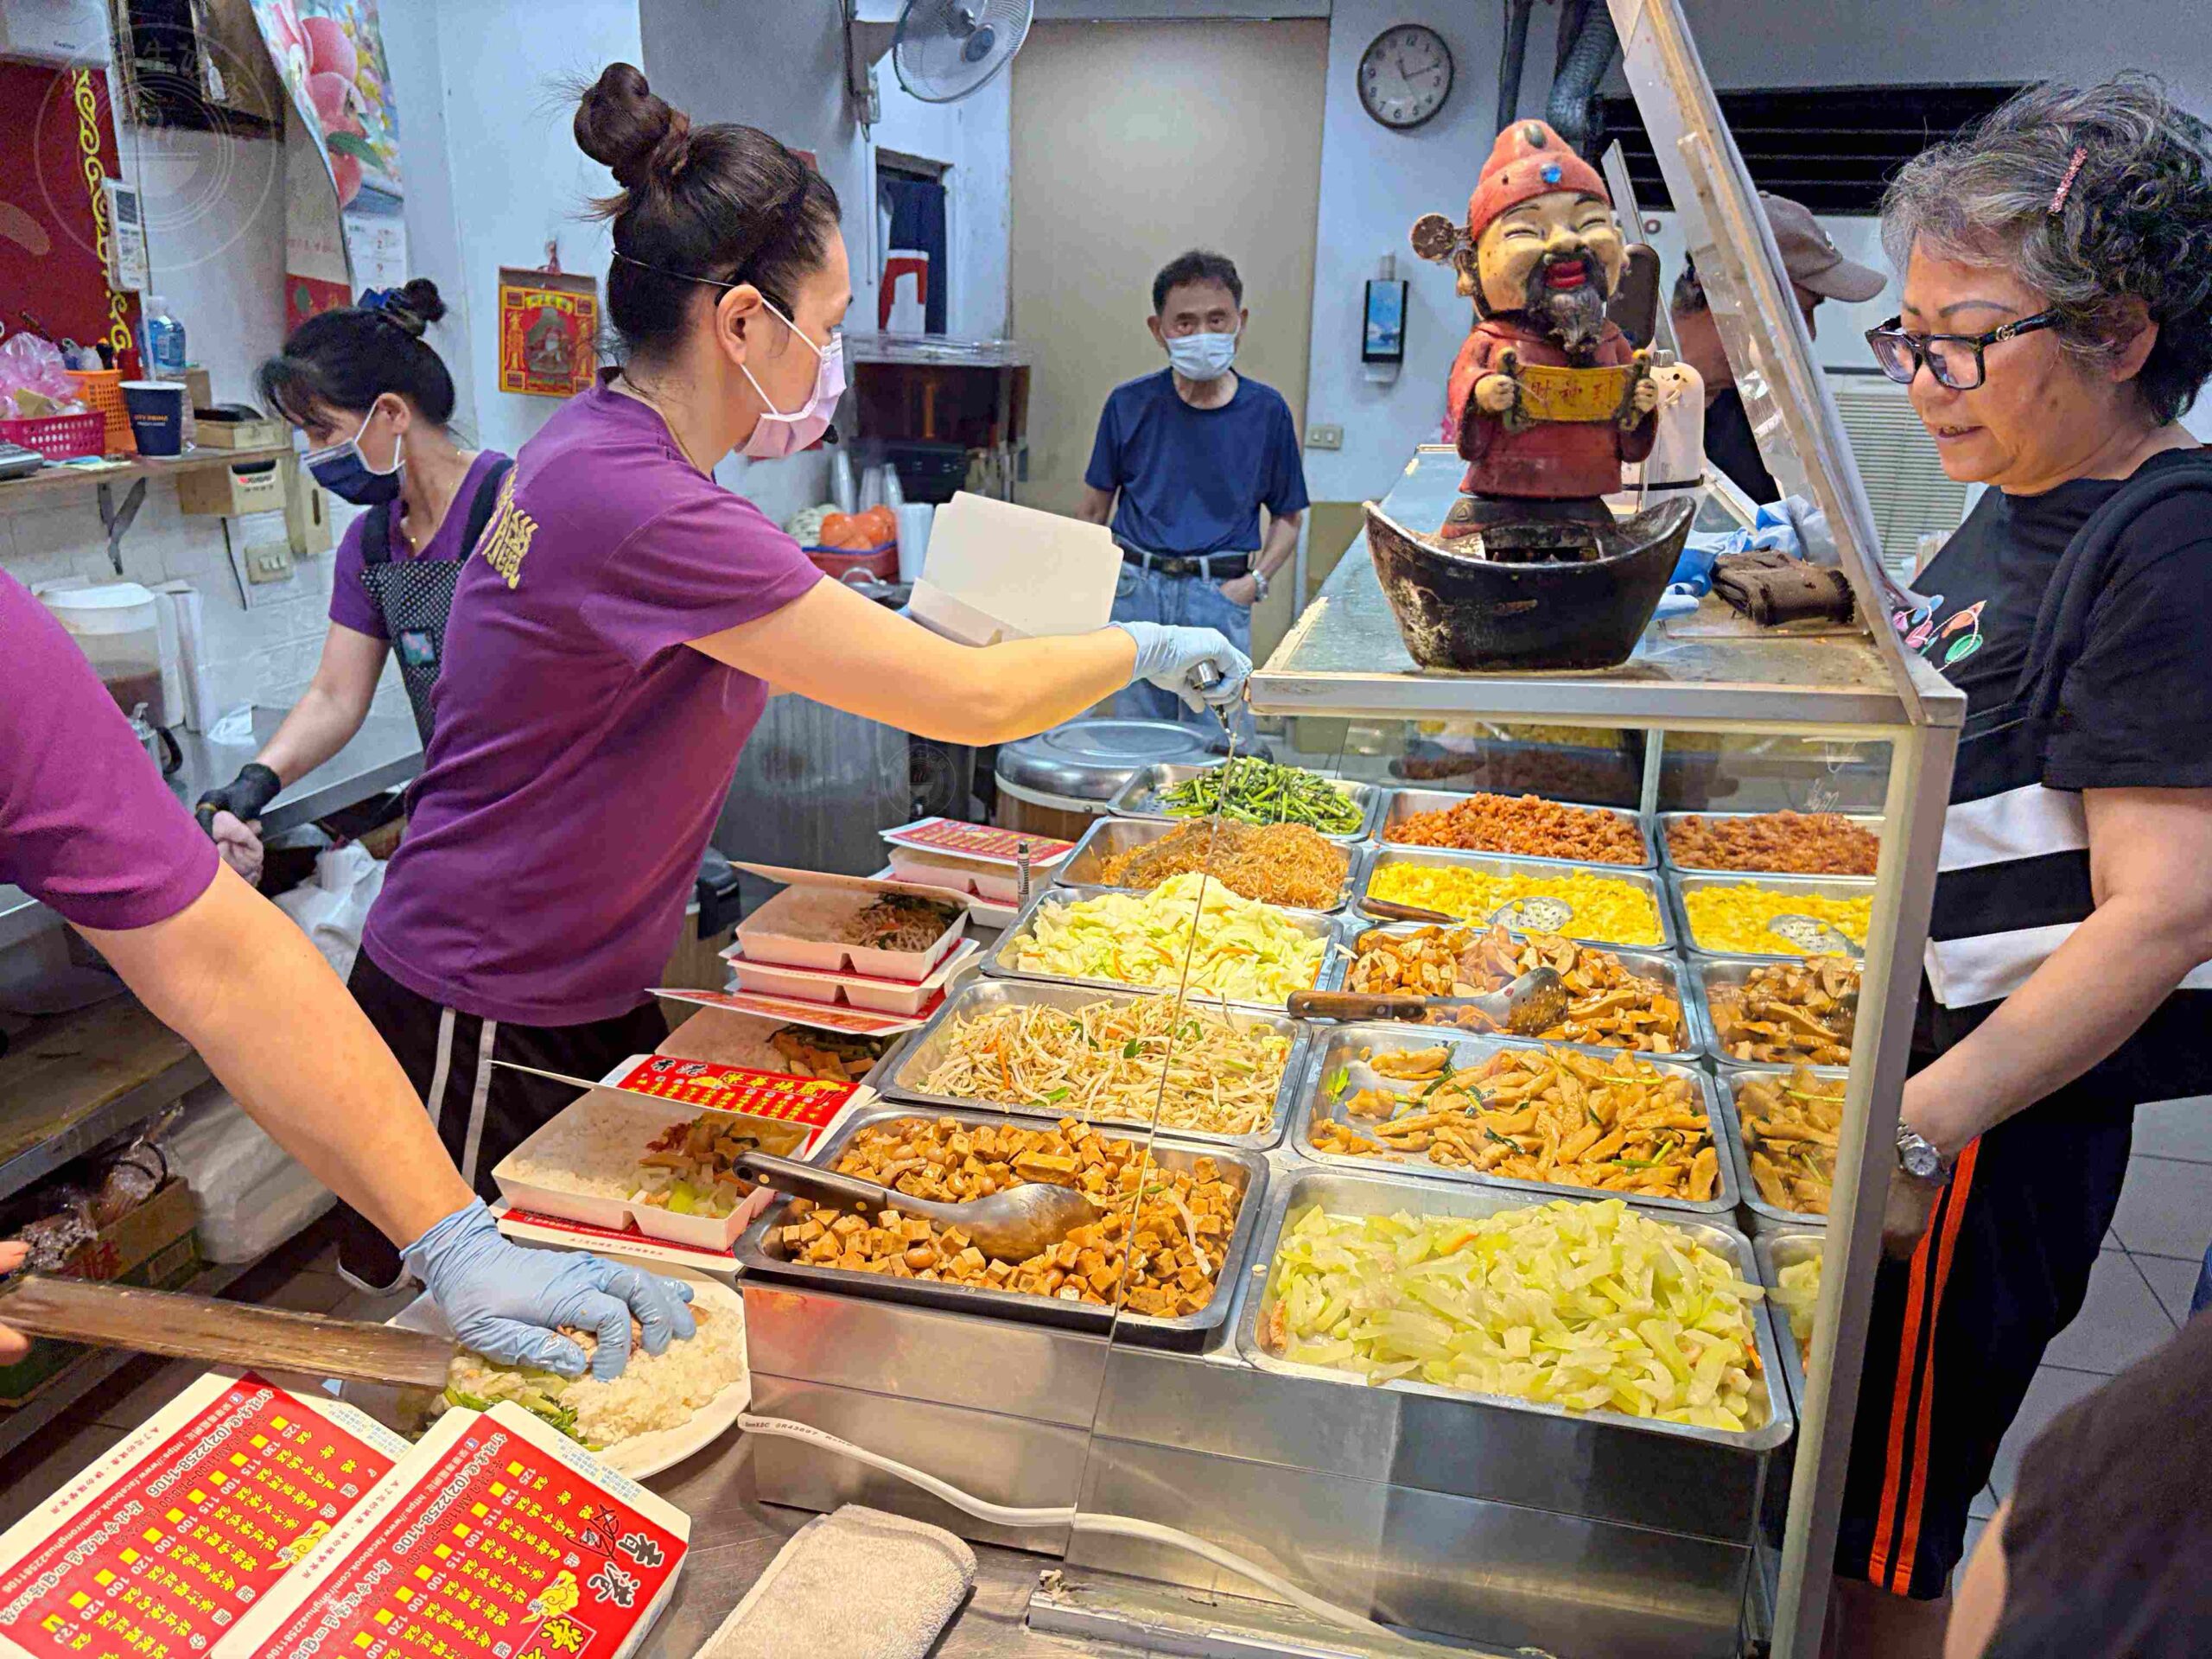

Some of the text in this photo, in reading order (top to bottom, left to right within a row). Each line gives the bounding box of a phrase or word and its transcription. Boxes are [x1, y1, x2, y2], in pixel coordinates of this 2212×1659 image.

[280, 1421, 302, 1440] 125
[261, 1439, 281, 1458] 130
[296, 1433, 355, 1472] 招牌飯
[239, 1457, 262, 1478] 115
[517, 1465, 537, 1485] 125
[219, 1475, 240, 1497] 100
[499, 1487, 519, 1506] 130
[197, 1494, 219, 1515] 115
[534, 1478, 592, 1518] 招牌飯
[175, 1513, 198, 1534] 100
[481, 1507, 502, 1528] 115
[153, 1532, 176, 1554] 100
[463, 1527, 485, 1549] 100
[130, 1553, 154, 1575] 120
[444, 1548, 467, 1570] 115
[425, 1569, 448, 1592] 100
[588, 1534, 666, 1610] 香港
[105, 1573, 130, 1597] 100
[79, 1596, 105, 1620] 120
[406, 1591, 429, 1614] 100
[385, 1612, 409, 1637] 120
